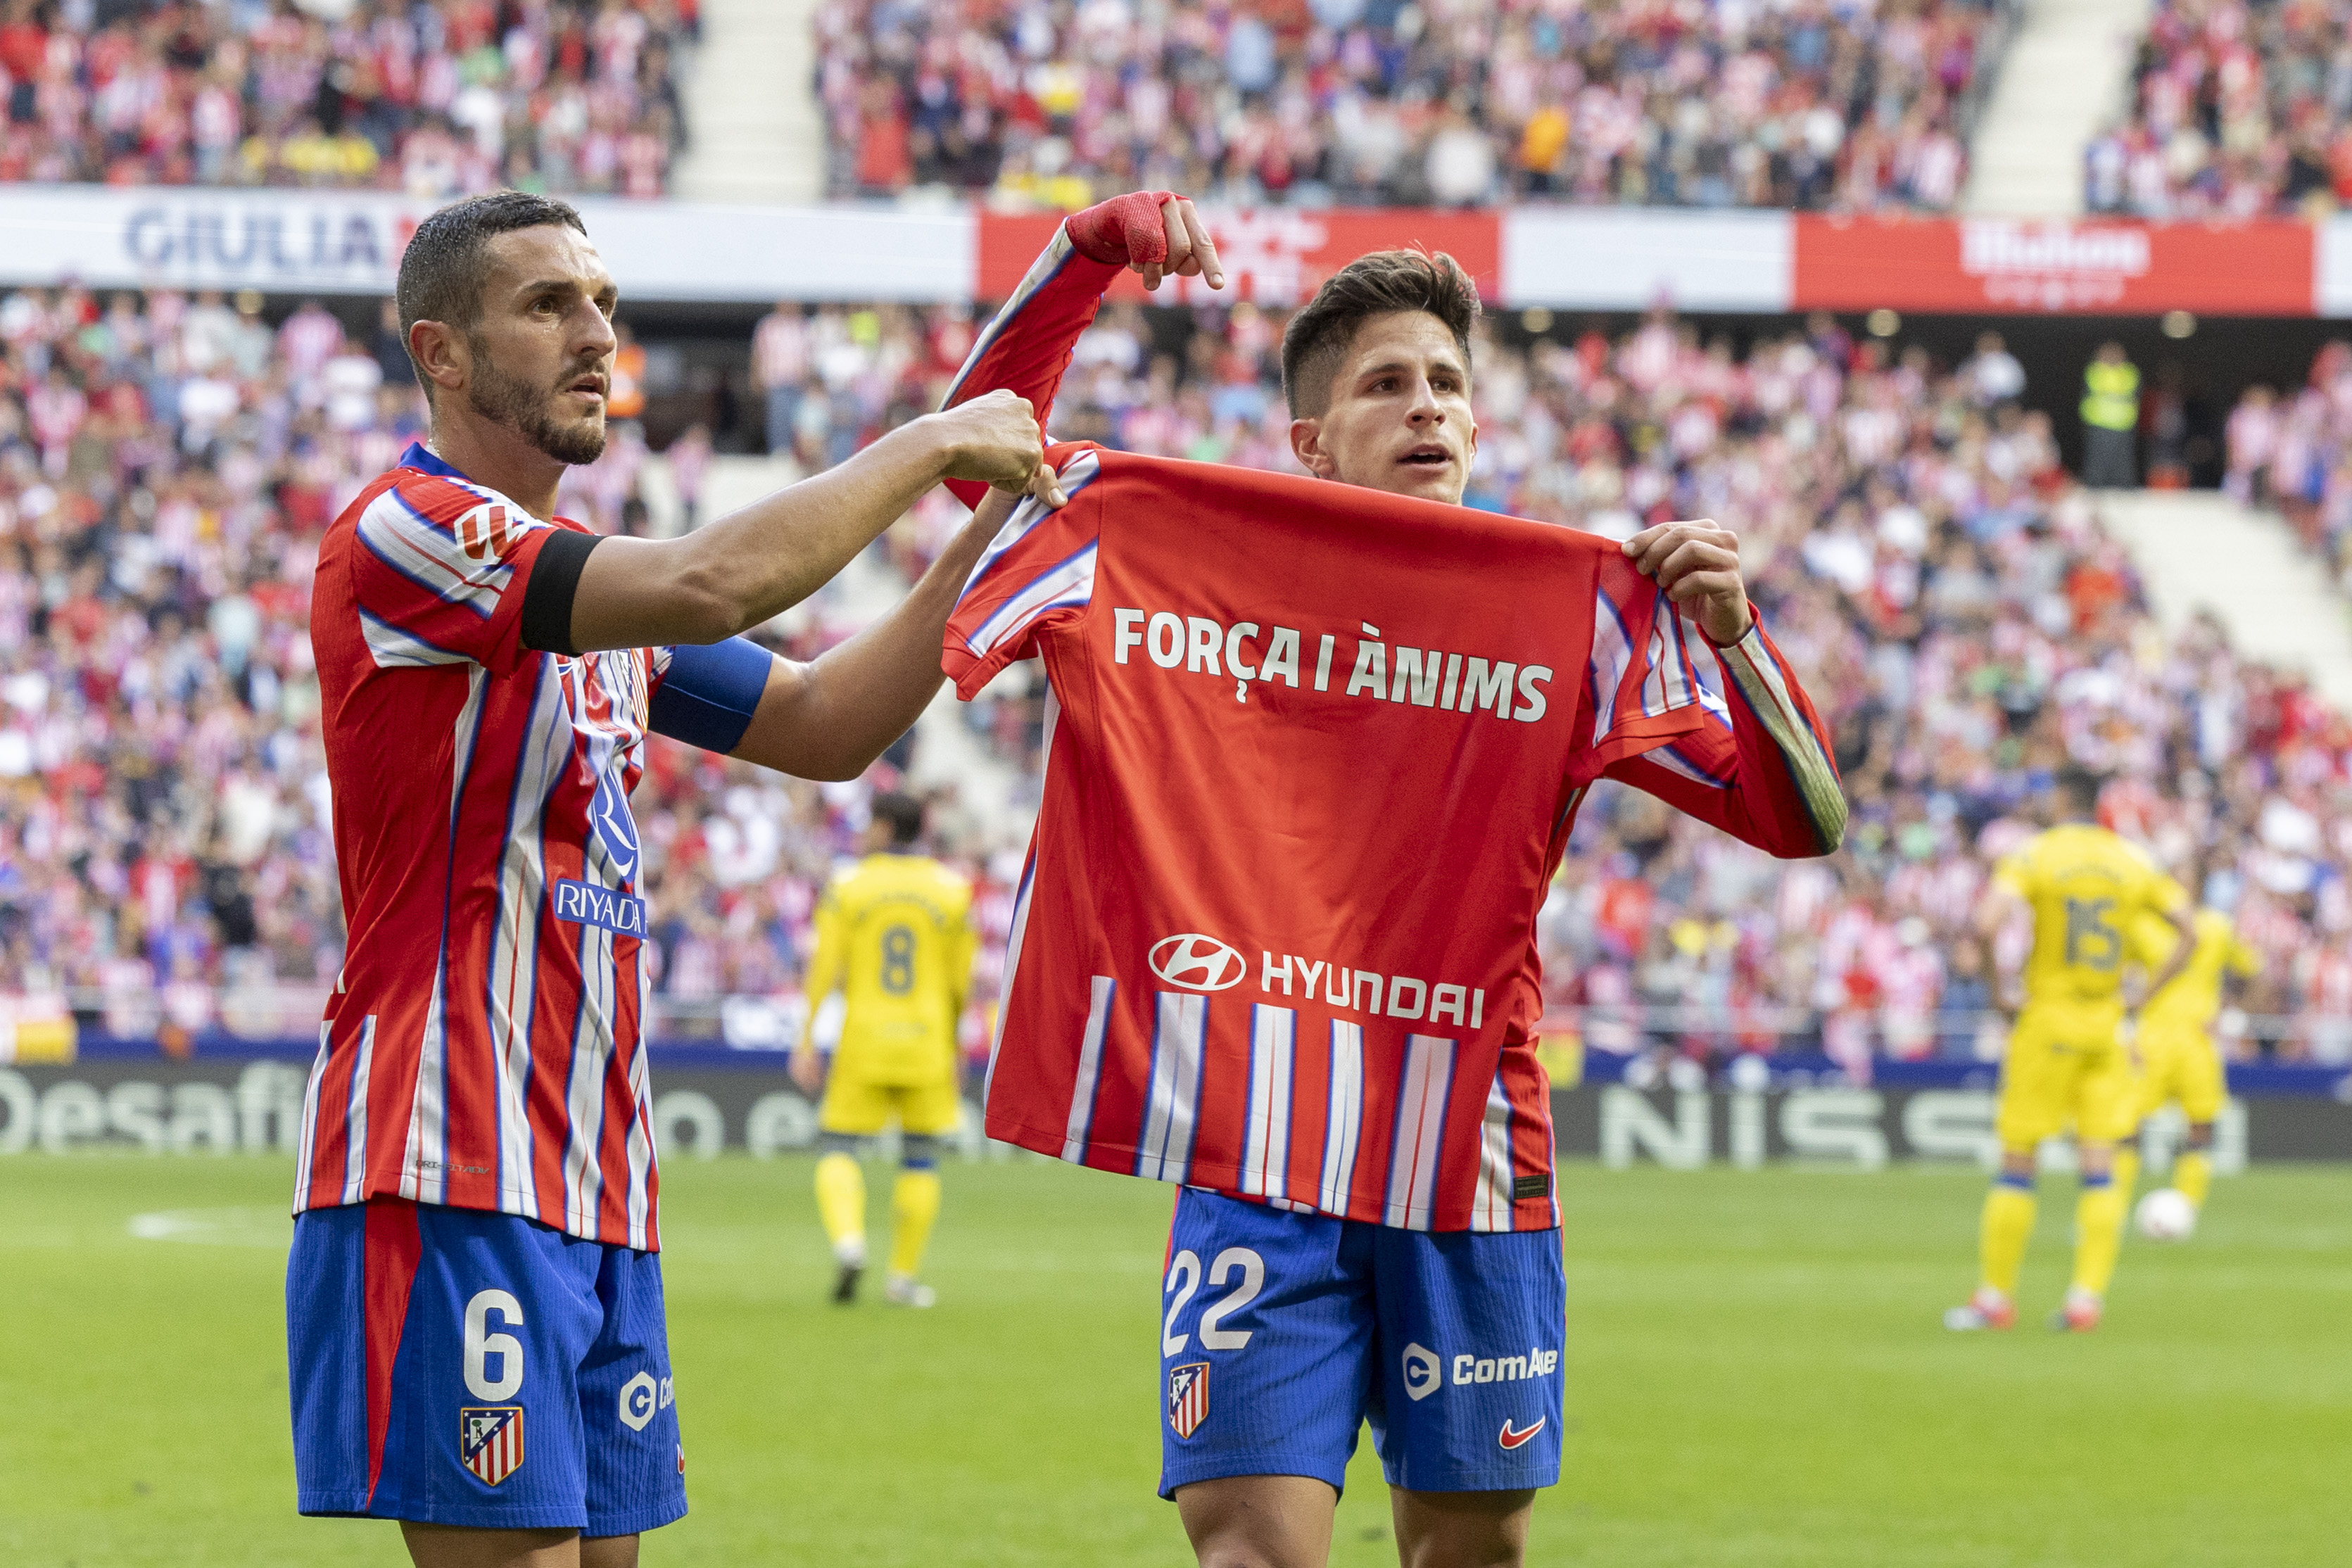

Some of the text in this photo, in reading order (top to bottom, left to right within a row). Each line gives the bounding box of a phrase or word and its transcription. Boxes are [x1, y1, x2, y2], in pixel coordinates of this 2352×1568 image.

[1114, 607, 1554, 723] FORÇA I ÀNIMS
[880, 923, 917, 997] 8
[2065, 895, 2123, 971] 15
[1261, 950, 1485, 1029] HYUNDAI
[1599, 1086, 2249, 1174] NISSN
[463, 1289, 524, 1402] 6
[1163, 1247, 1265, 1359] 22
